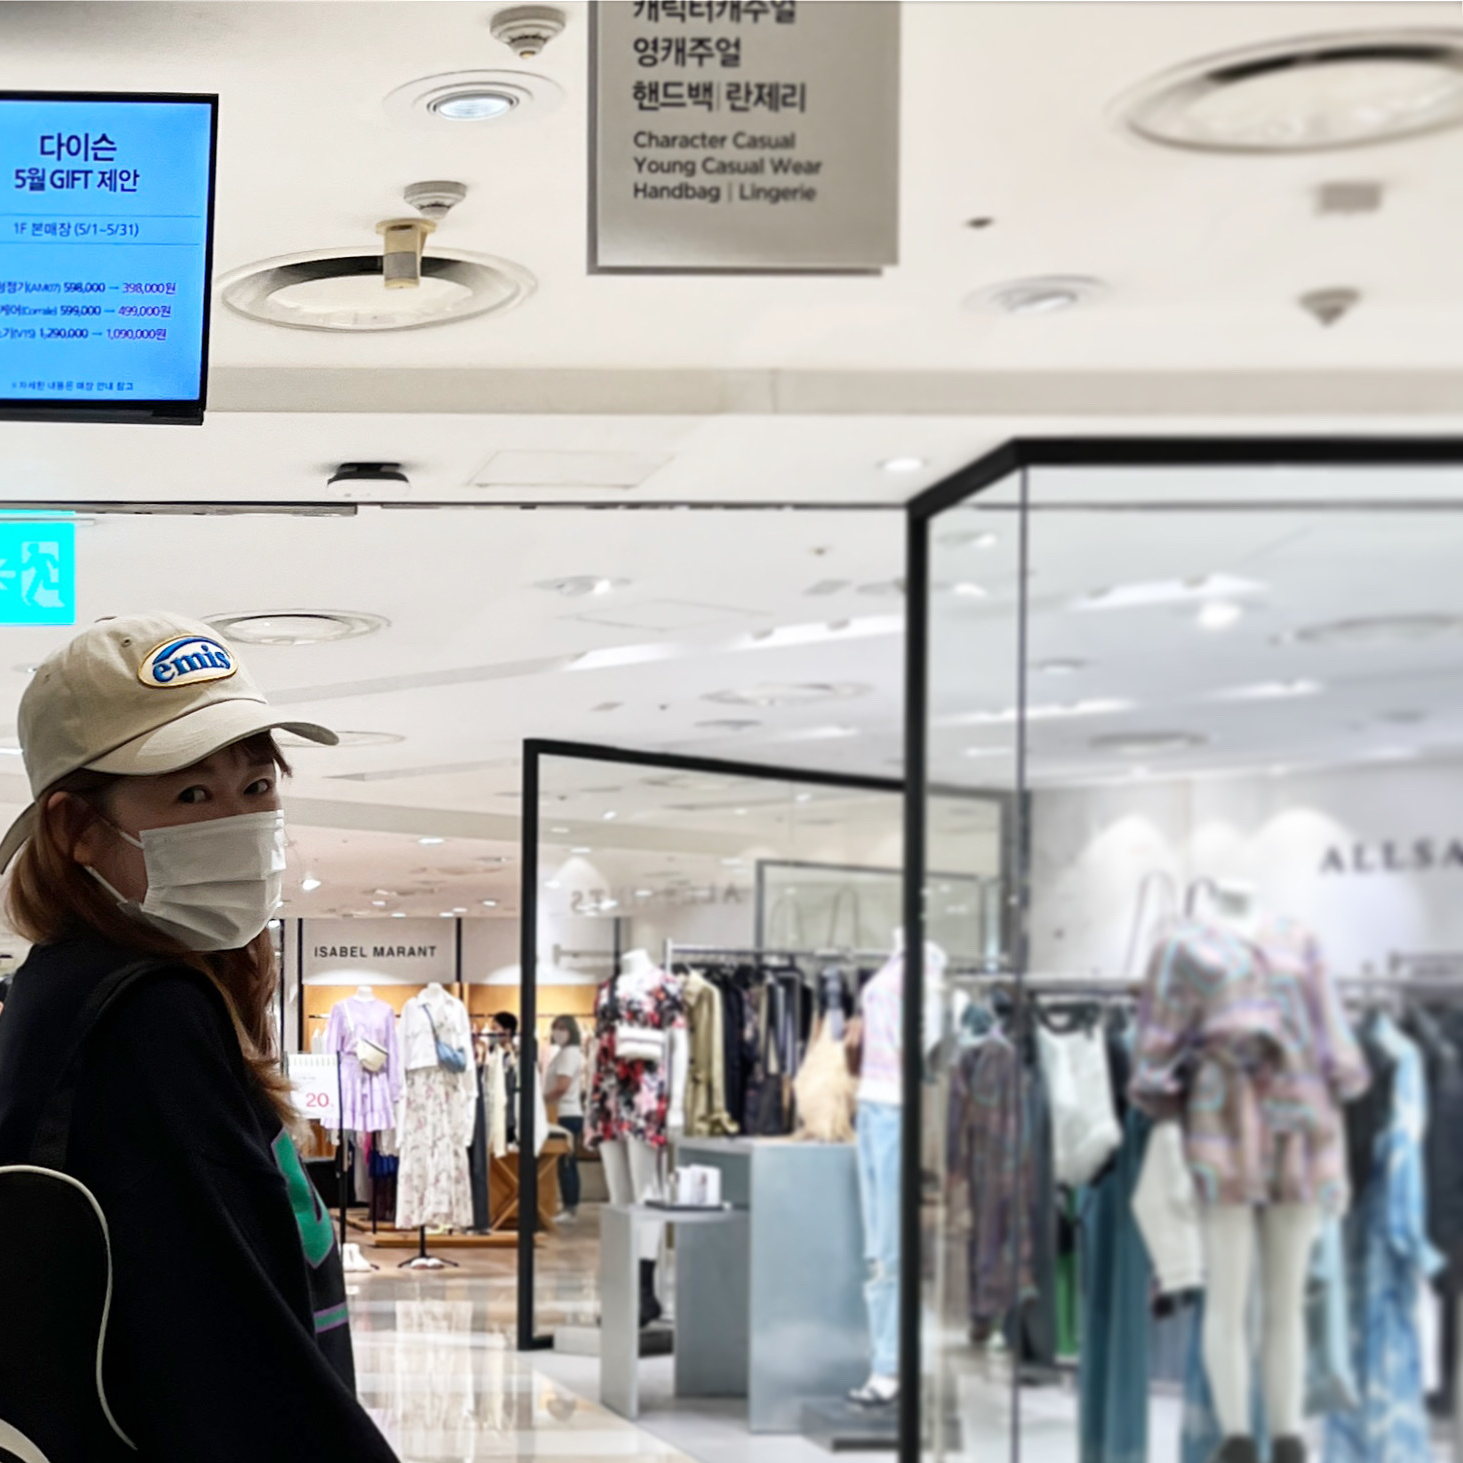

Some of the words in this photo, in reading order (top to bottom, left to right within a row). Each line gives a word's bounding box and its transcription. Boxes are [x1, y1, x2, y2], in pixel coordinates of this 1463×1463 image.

[633, 37, 741, 67] 영캐주얼
[633, 81, 713, 112] 핸드백
[726, 82, 806, 113] 란제리
[40, 132, 117, 162] 다이슨
[633, 131, 727, 149] Character
[733, 132, 796, 149] Casual
[633, 157, 696, 177] Young
[701, 157, 765, 175] Casual
[770, 158, 822, 175] Wear
[14, 167, 45, 191] 5월
[50, 169, 93, 190] GIFT
[97, 168, 140, 192] 제안
[633, 182, 721, 203] Handbag
[739, 182, 817, 204] Lingerie
[14, 222, 27, 235] 1F
[31, 222, 71, 237] 본매장
[74, 222, 139, 238] (5/1~5/31)
[63, 281, 105, 294] 598,000
[152, 644, 232, 683] emis
[314, 946, 367, 958] ISABEL
[373, 946, 436, 957] MARANT
